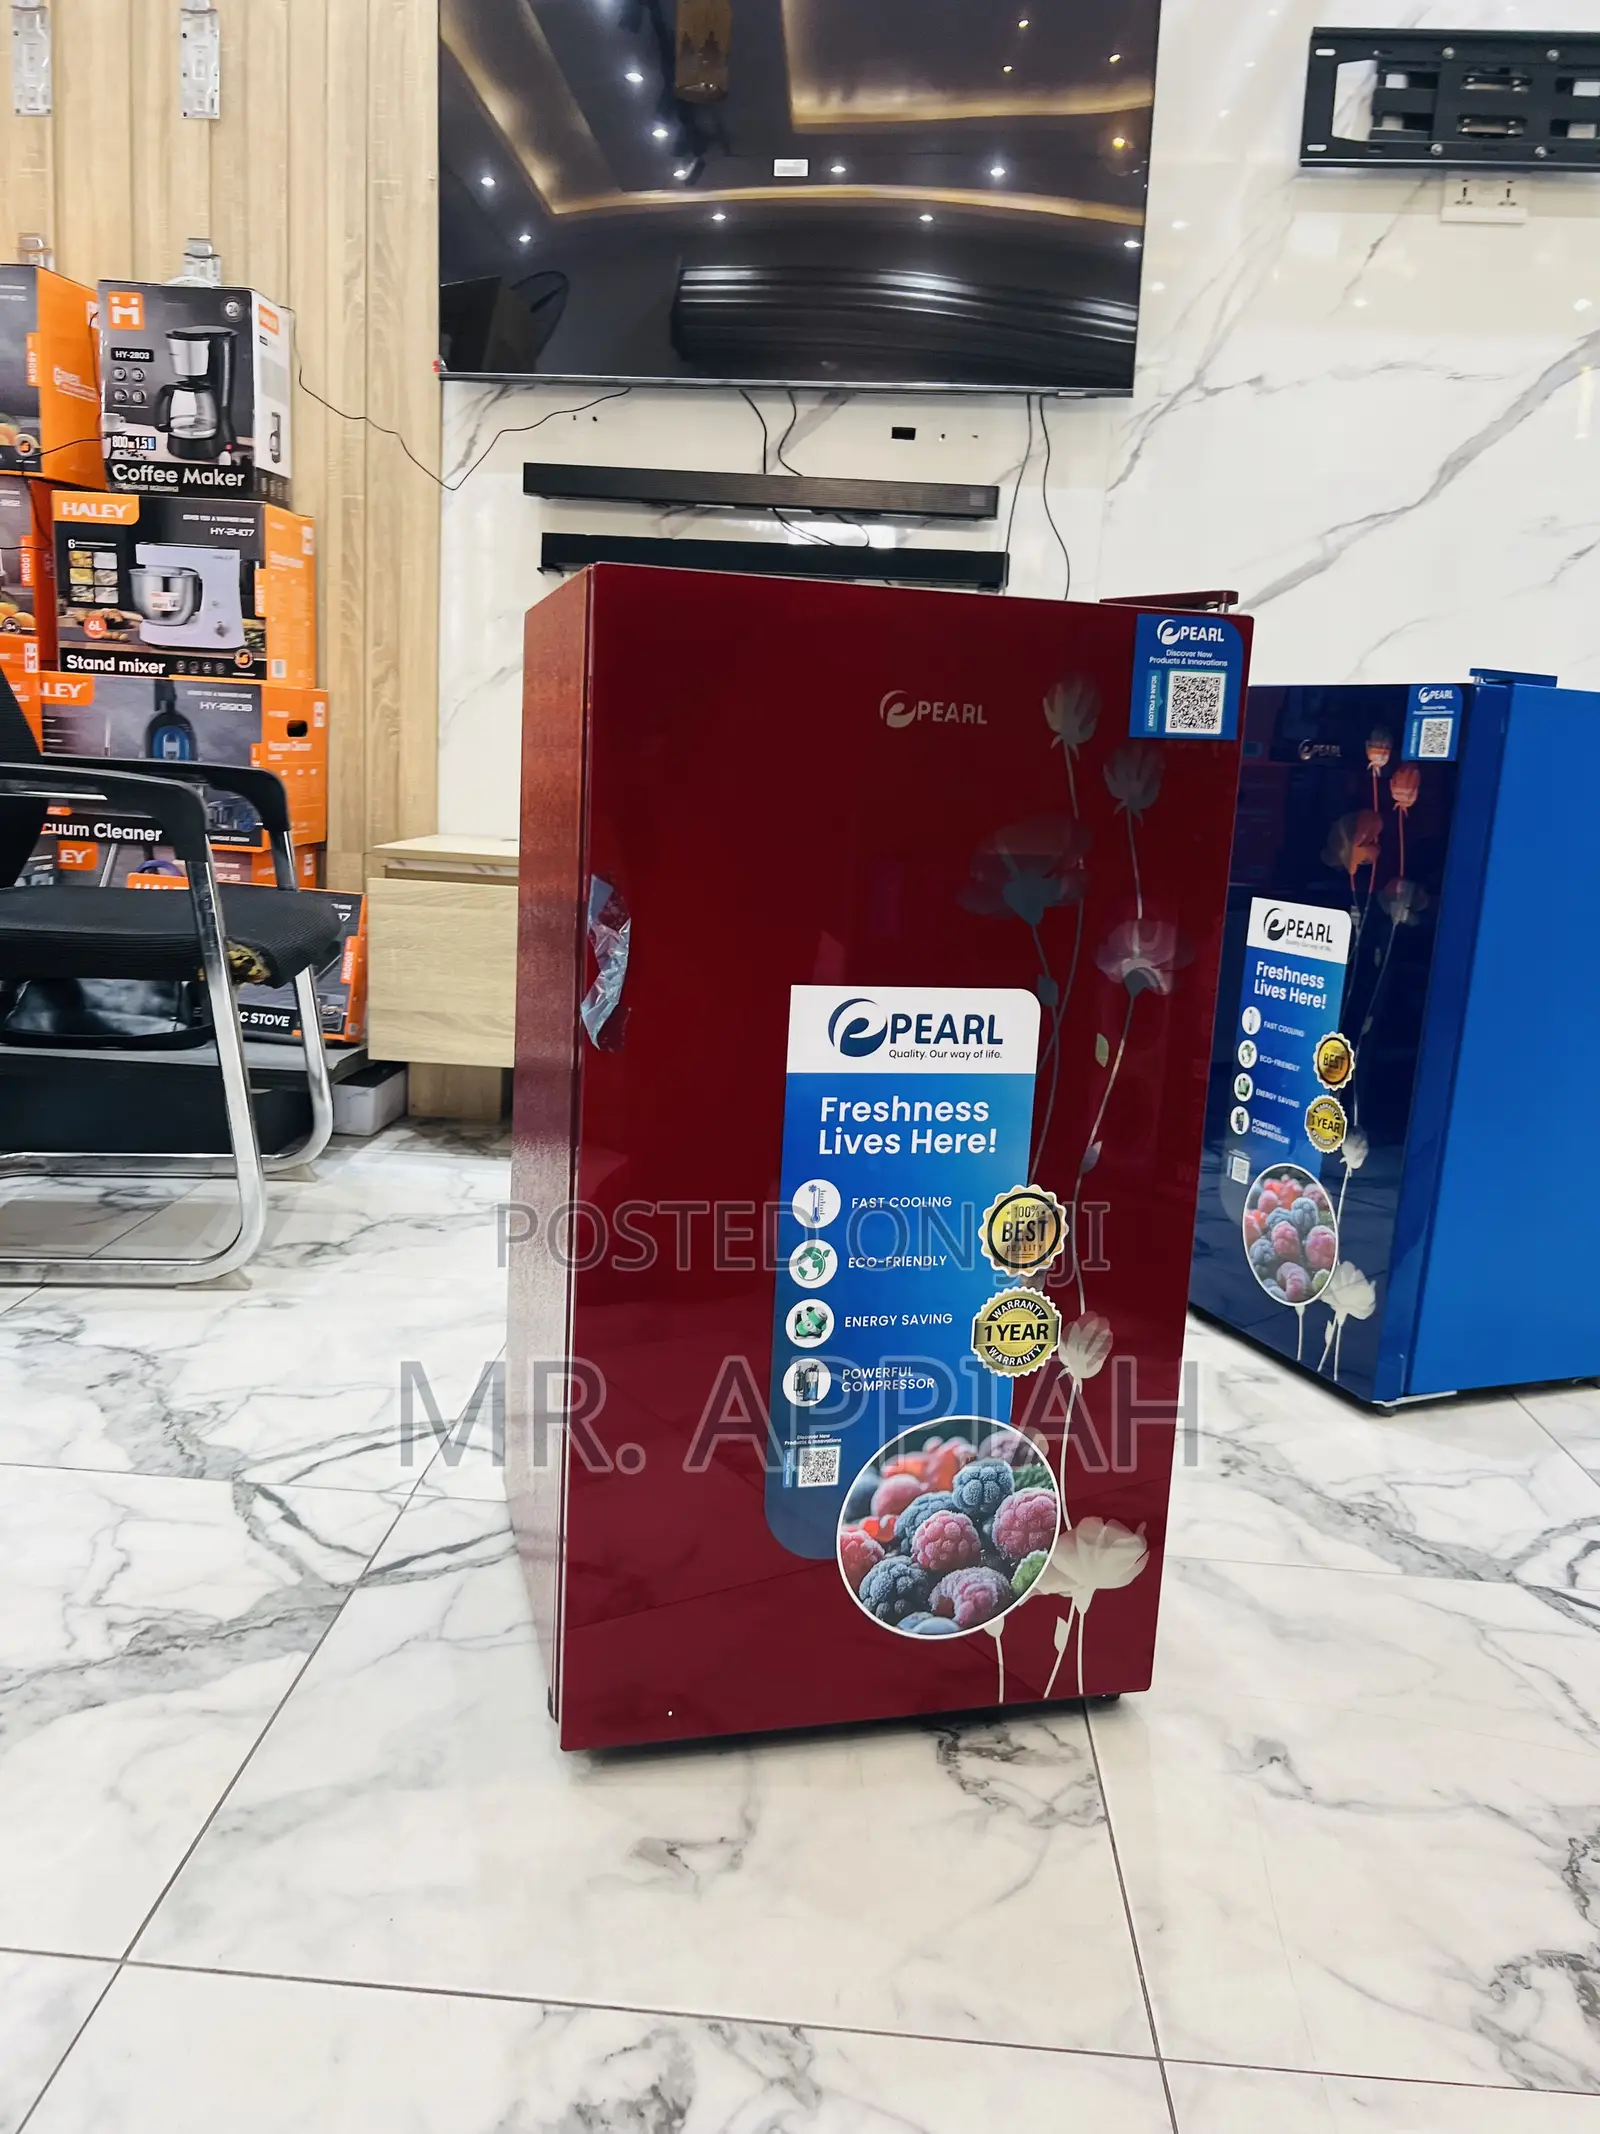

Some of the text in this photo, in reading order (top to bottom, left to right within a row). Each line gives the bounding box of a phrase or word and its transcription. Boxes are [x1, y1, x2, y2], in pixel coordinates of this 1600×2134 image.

[112, 463, 178, 483] Coffee
[183, 468, 245, 487] Maker
[61, 501, 126, 519] HALEY
[88, 620, 102, 631] 6L
[1180, 626, 1225, 642] PEARL
[1149, 656, 1180, 665] Products
[1187, 659, 1228, 667] Innovations
[1166, 649, 1196, 658] Discover
[66, 654, 166, 674] Stand mixer
[40, 682, 83, 698] LEY
[917, 701, 987, 725] PEARL
[41, 822, 163, 842] cuum Cleaner
[1286, 918, 1333, 943] PEARL
[1256, 960, 1325, 989] Freshness
[1253, 979, 1328, 1010] Lives Here!
[238, 1011, 290, 1027] C STOVE
[890, 1013, 1004, 1045] PEARL
[889, 1049, 1003, 1061] Quality. Our way of life.
[820, 1095, 990, 1123] Freshness
[1317, 1117, 1341, 1133] YEAR
[818, 1127, 997, 1155] Lives Here!
[851, 1196, 953, 1209] FAST COOLING
[1014, 1205, 1040, 1219] 100%
[1002, 1220, 1048, 1243] BEST
[848, 1255, 948, 1268] ECO-FRIENDLY
[992, 1299, 1044, 1319] WARRANTY
[844, 1313, 953, 1328] ENERGY SAVING
[985, 1323, 1049, 1342] 1 YEAR
[989, 1346, 1041, 1366] WARRANTY
[842, 1366, 914, 1380] POWERFUL
[841, 1378, 935, 1393] COMPRESSOR
